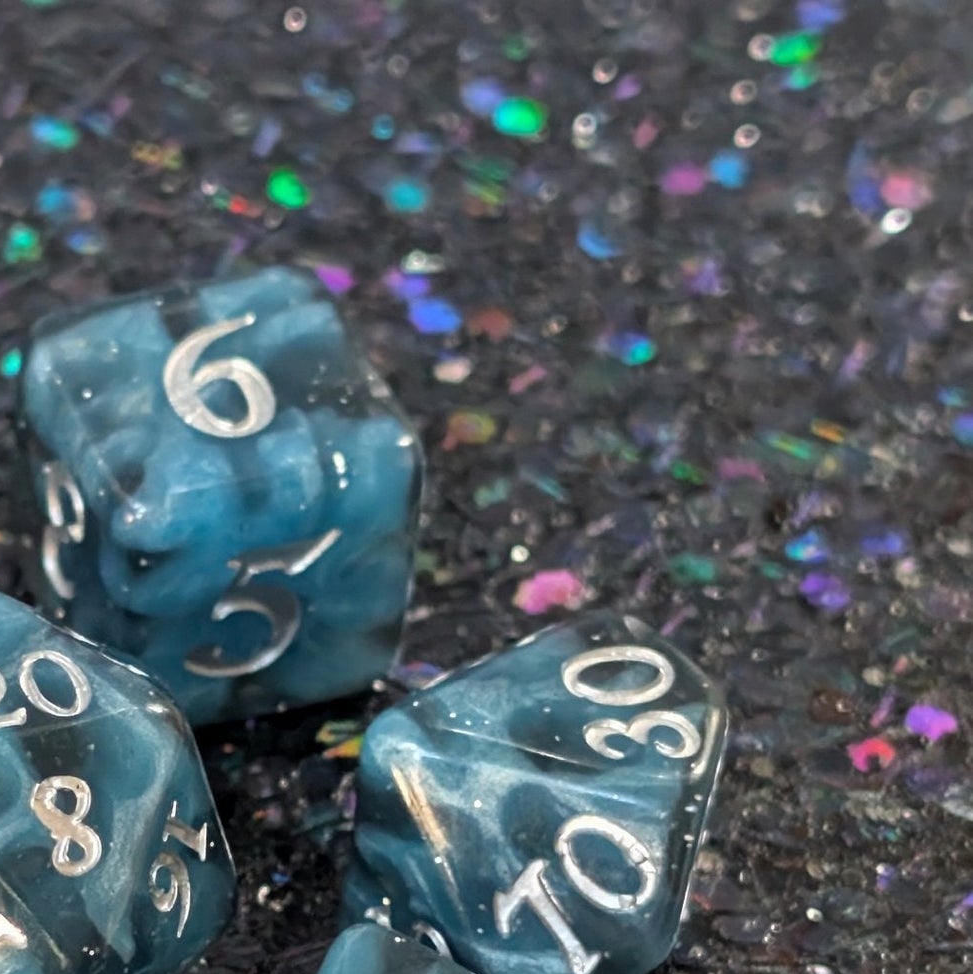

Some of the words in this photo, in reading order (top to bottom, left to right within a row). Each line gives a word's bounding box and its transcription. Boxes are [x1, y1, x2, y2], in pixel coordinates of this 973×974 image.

[163, 311, 277, 438] 6
[184, 528, 343, 678] 5
[561, 645, 701, 759] 30
[31, 775, 102, 877] 8
[148, 800, 208, 939] 16
